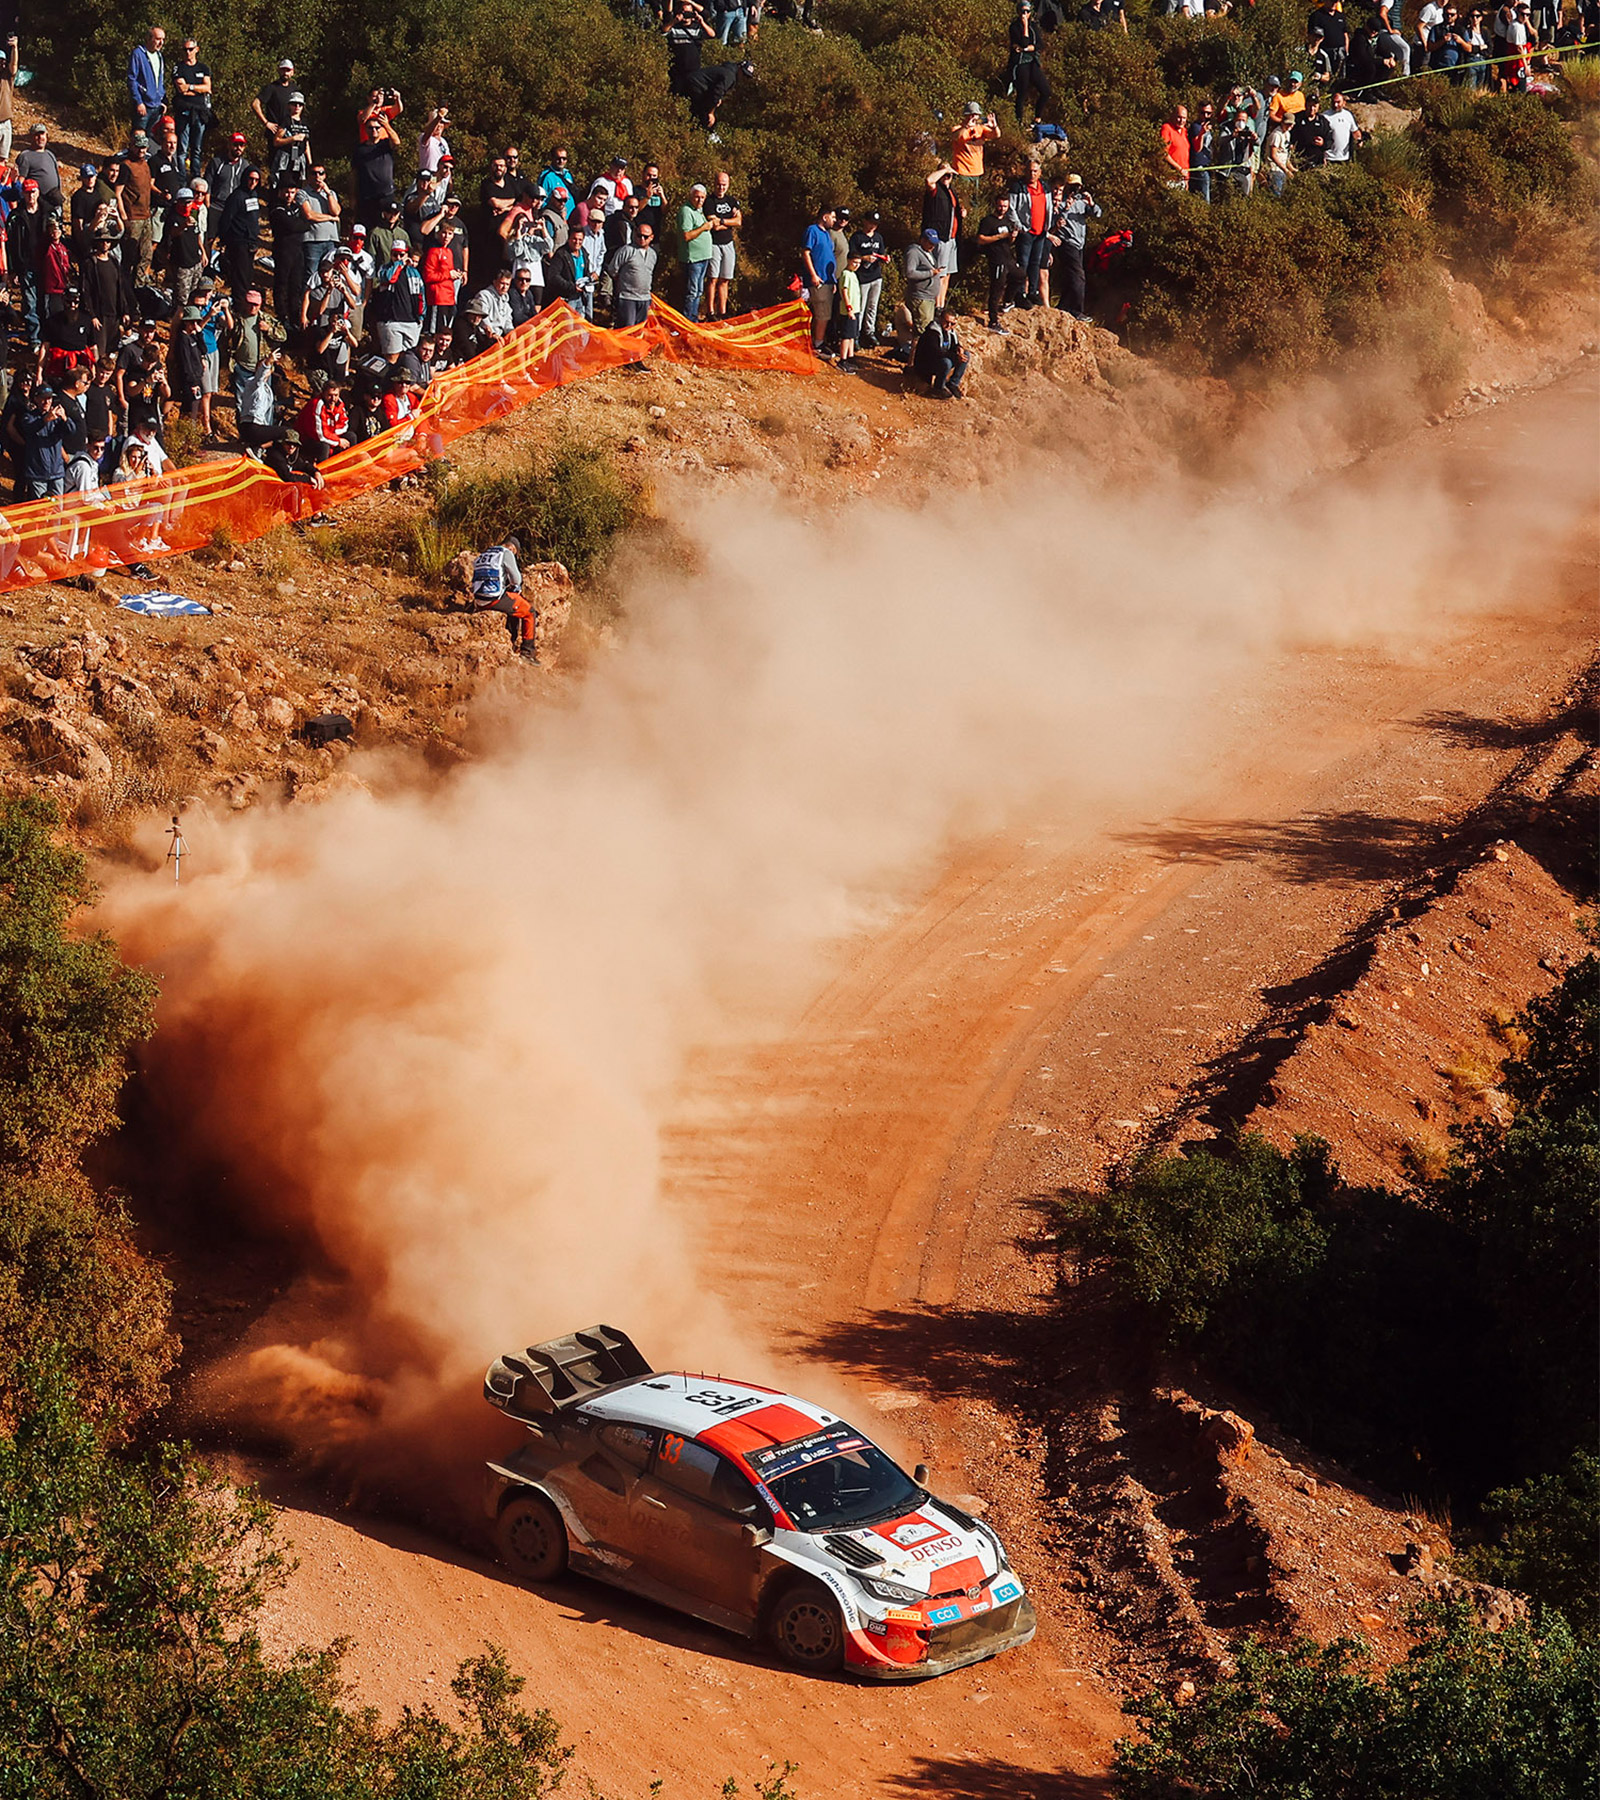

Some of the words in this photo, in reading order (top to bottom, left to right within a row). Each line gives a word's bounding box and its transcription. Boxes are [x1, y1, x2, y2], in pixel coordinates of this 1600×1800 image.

[659, 1433, 685, 1464] 33
[775, 1443, 804, 1456] TOYOTA
[810, 1447, 833, 1458] WRC
[911, 1536, 962, 1561] DENSO
[820, 1571, 856, 1624] Panasonic
[999, 1586, 1014, 1597] CCI
[936, 1610, 954, 1621] CCI
[868, 1622, 886, 1633] OMP
